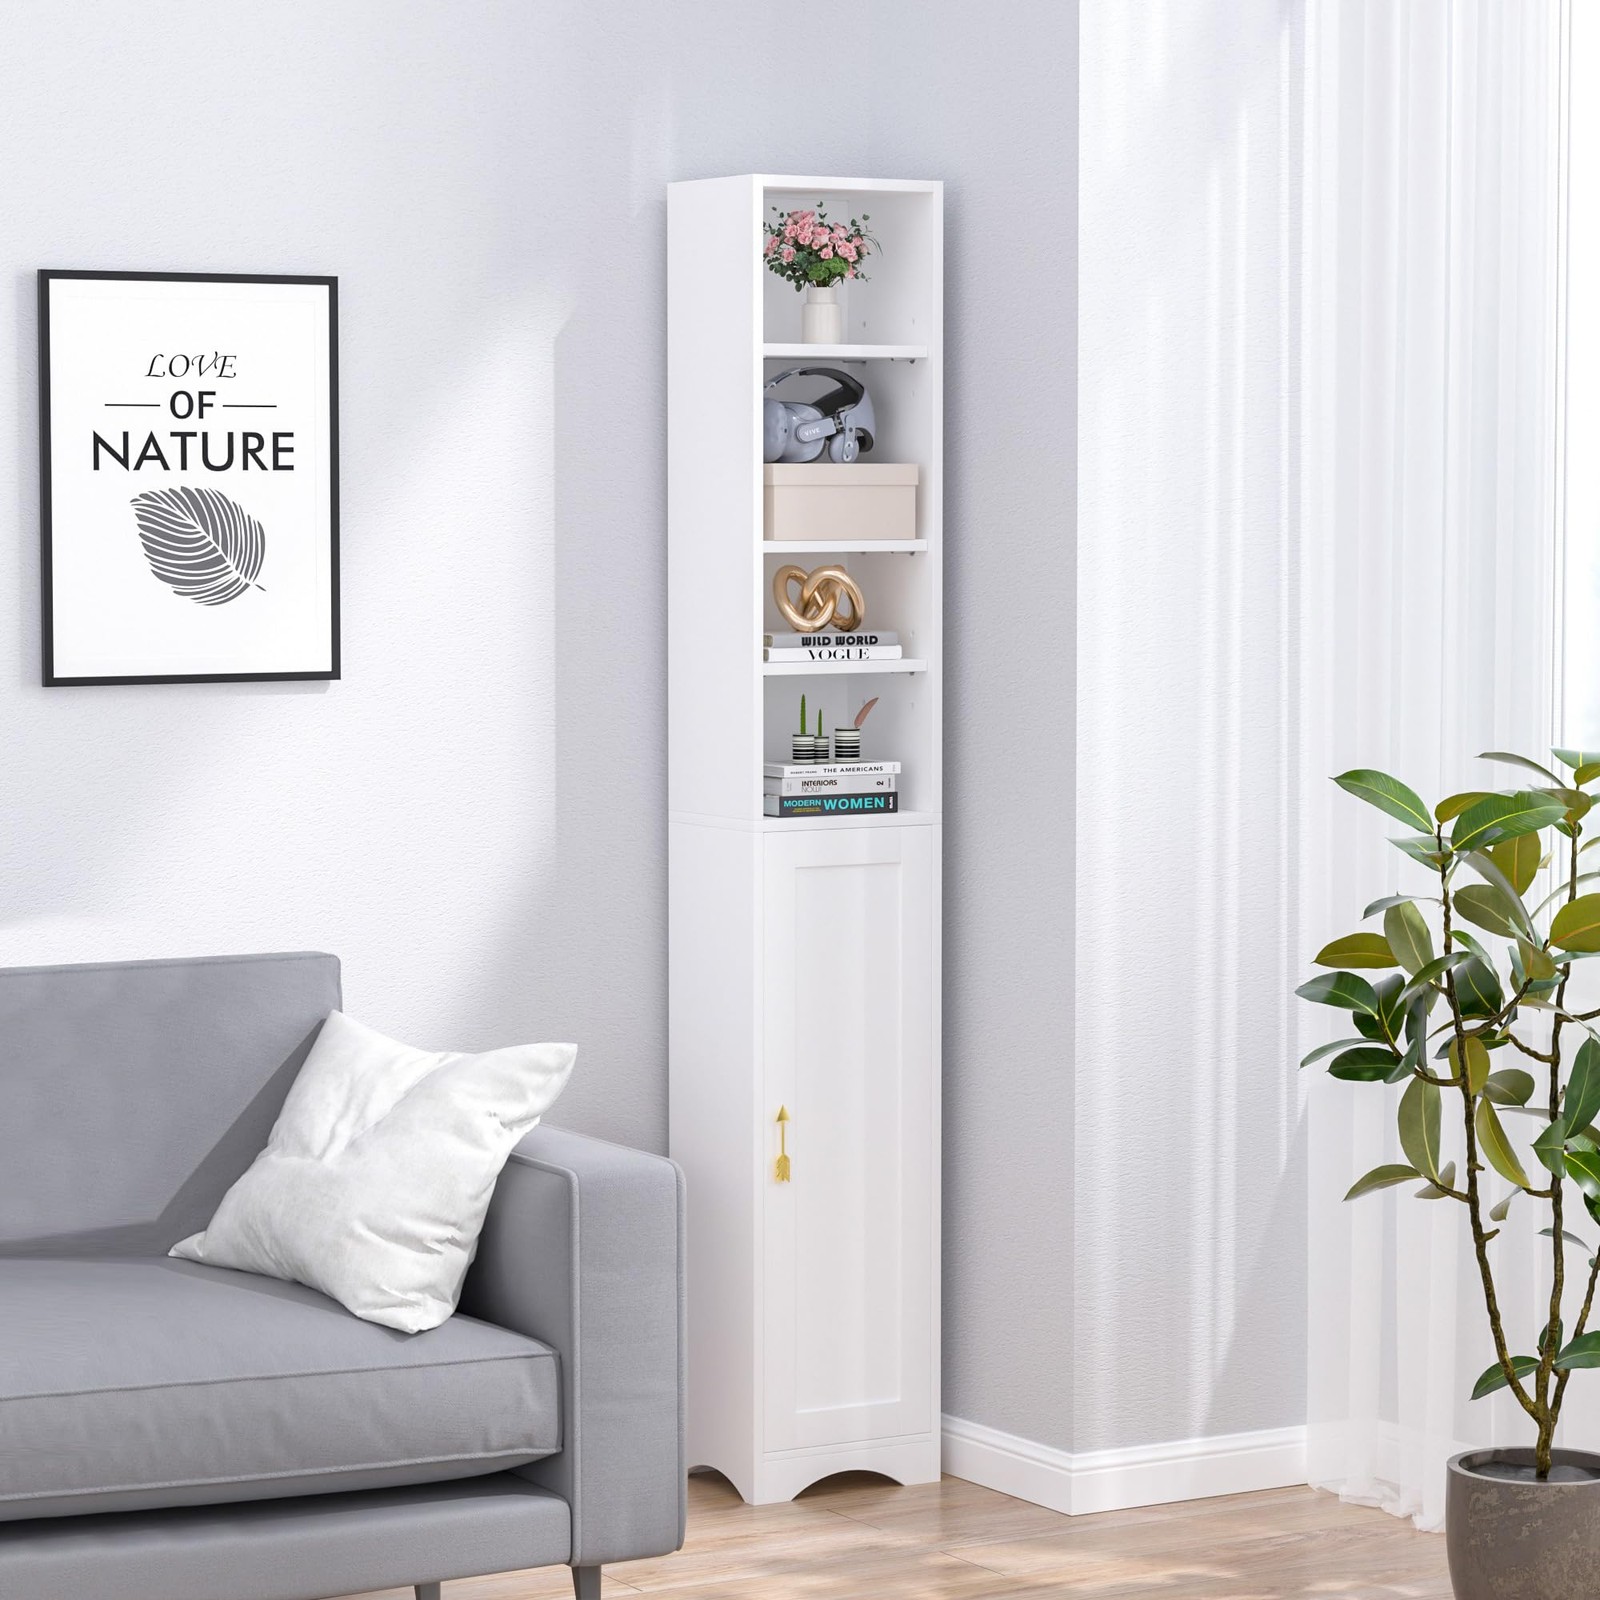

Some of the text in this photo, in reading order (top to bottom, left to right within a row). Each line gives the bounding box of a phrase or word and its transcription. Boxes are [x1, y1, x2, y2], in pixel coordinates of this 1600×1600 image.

[145, 351, 237, 378] LOVE
[170, 390, 216, 419] OF
[804, 427, 821, 436] VIVE
[93, 430, 295, 472] NATURE
[801, 635, 879, 647] WILD WORLD
[808, 648, 870, 660] VOGUE
[801, 779, 838, 787] INTERIORS
[783, 799, 822, 807] MODERN
[823, 797, 885, 811] WOMEN
